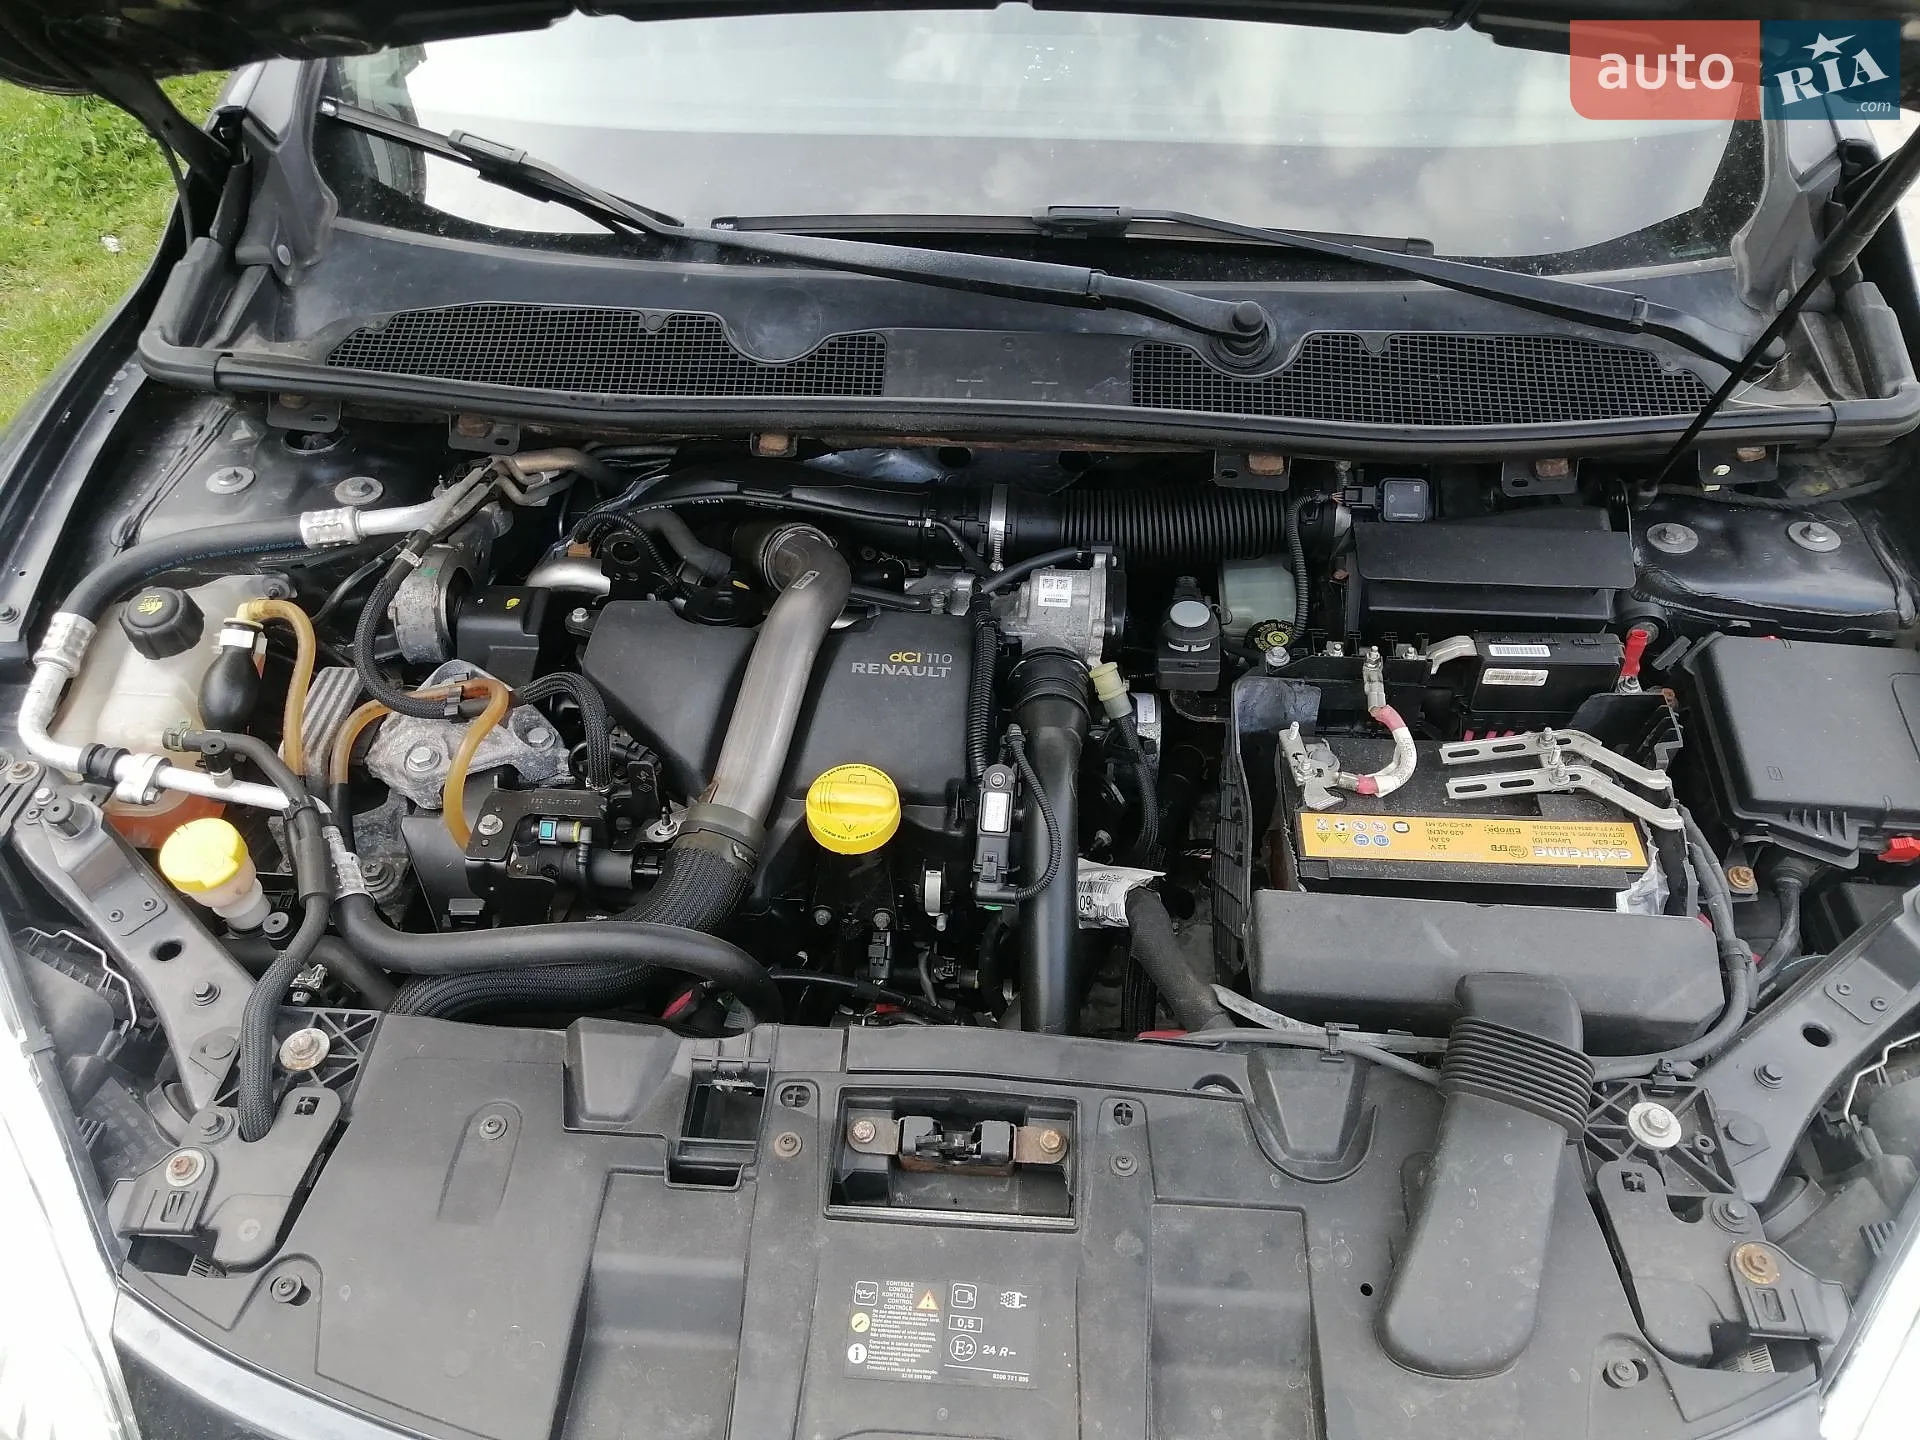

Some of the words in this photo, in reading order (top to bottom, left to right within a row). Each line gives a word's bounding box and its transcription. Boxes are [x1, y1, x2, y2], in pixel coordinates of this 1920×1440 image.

[926, 653, 953, 664] 110
[851, 662, 952, 678] RENAULT
[1490, 844, 1508, 852] EFB
[1532, 846, 1632, 862] extreme
[957, 1318, 975, 1329] 0,5
[954, 1339, 974, 1356] E2
[982, 1344, 996, 1356] 24
